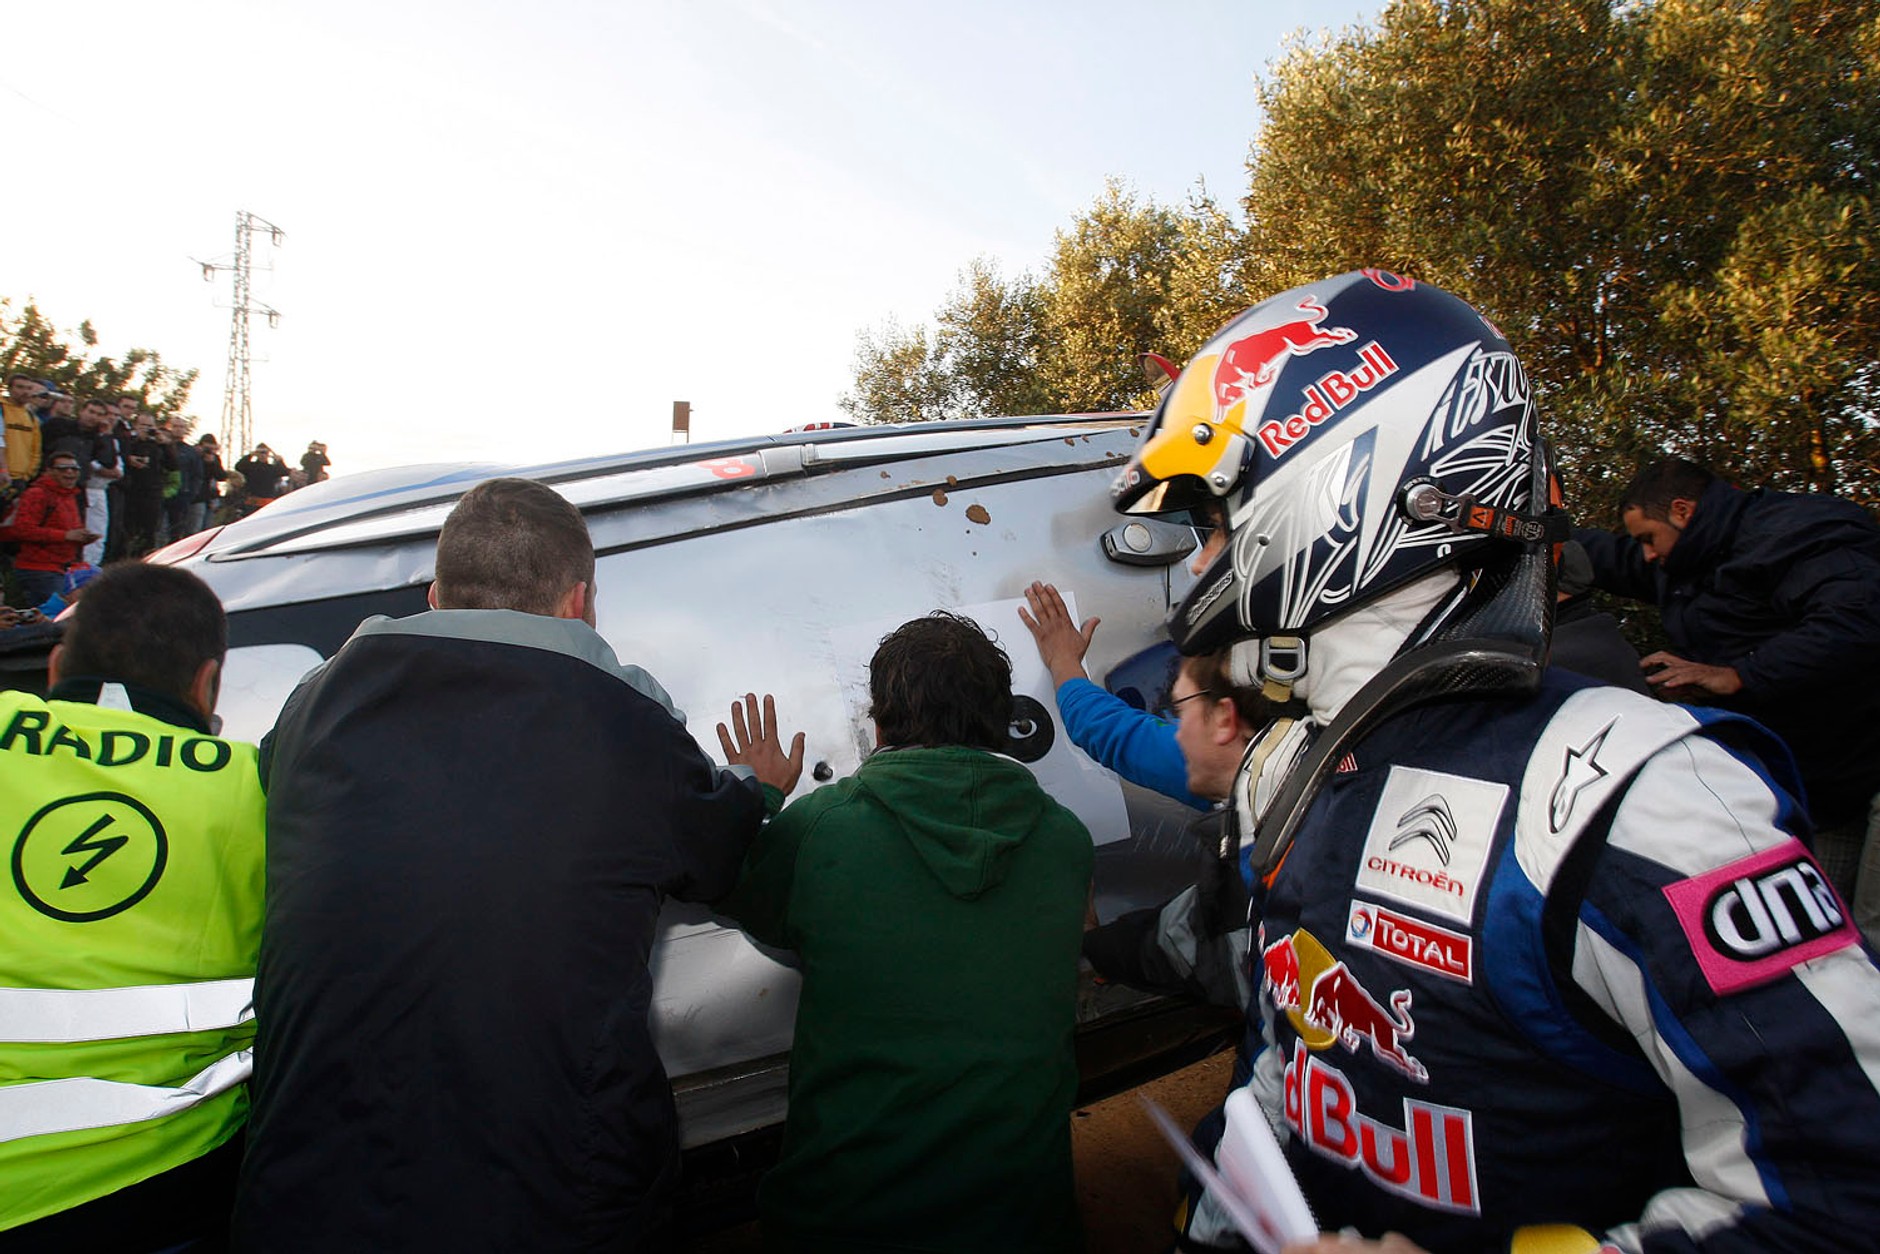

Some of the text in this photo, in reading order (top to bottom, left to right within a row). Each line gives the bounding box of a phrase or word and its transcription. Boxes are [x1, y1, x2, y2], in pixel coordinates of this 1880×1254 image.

[1257, 342, 1398, 457] Red Bull
[0, 710, 232, 772] RADIO
[1378, 917, 1464, 971] TOTAL
